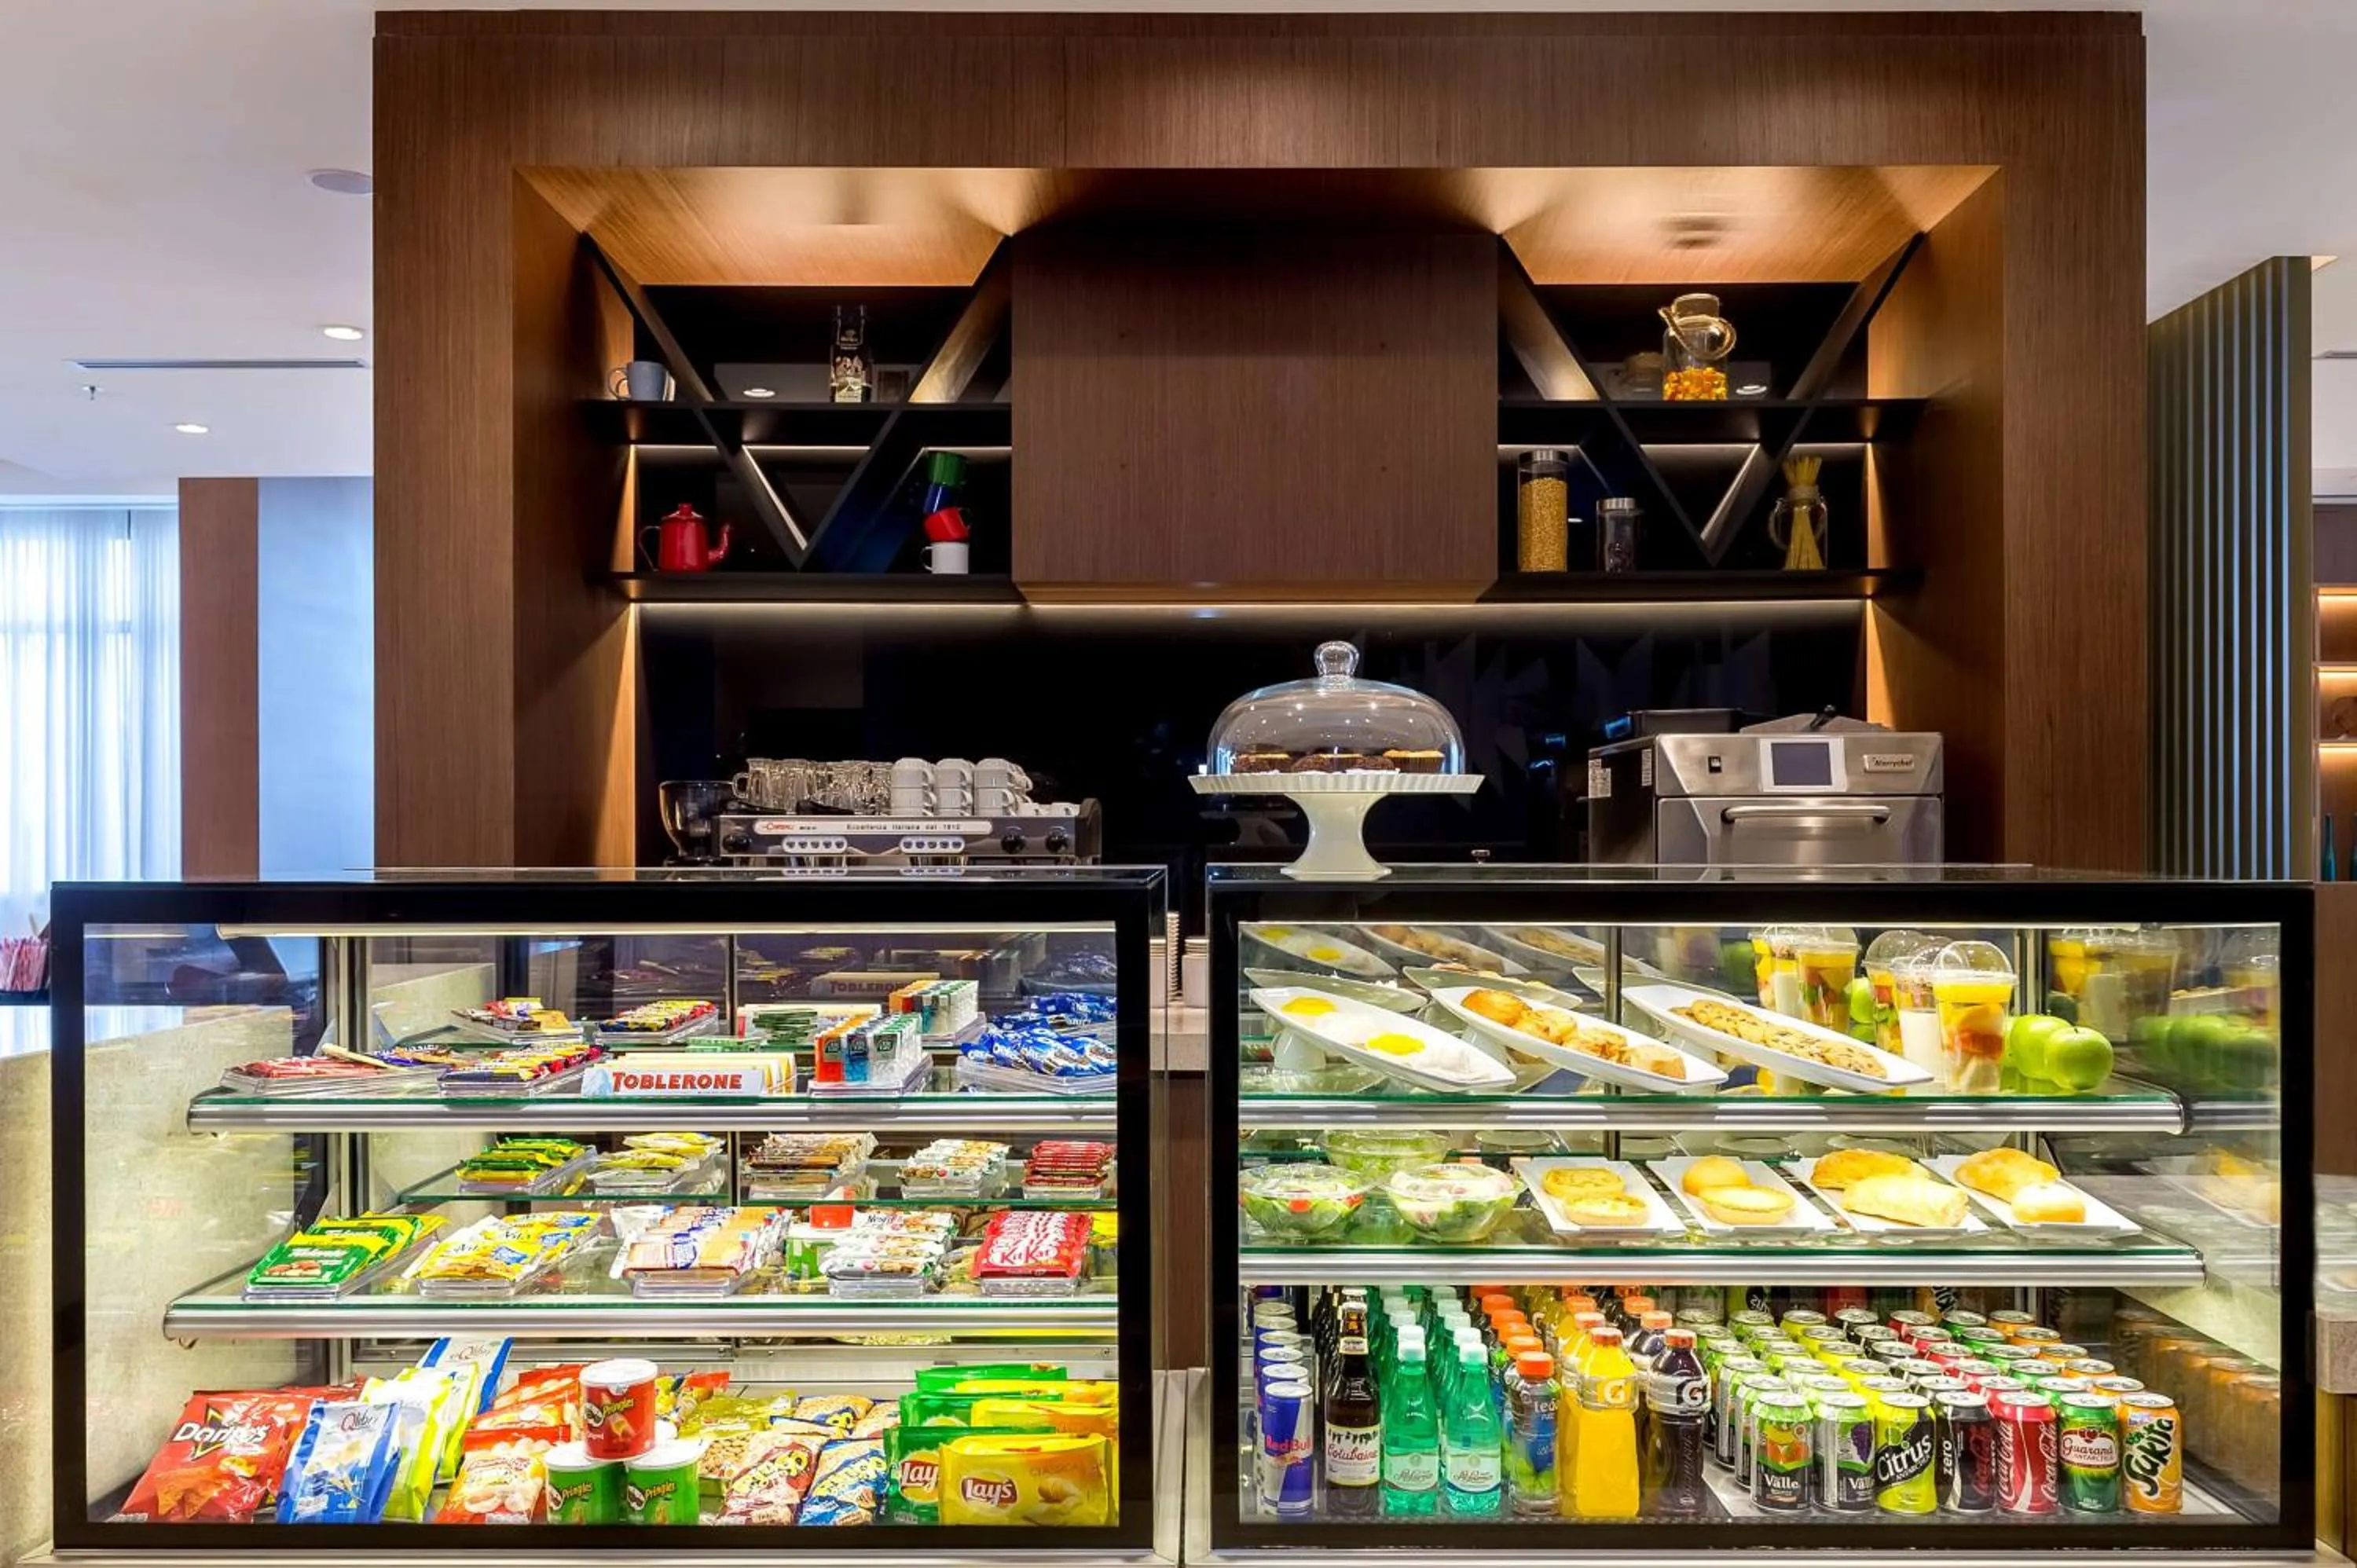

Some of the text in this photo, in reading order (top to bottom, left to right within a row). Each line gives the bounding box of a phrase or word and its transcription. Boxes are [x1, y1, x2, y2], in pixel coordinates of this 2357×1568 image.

[829, 981, 902, 995] TOBLERO
[612, 1072, 742, 1091] TOBLERONE
[1604, 1380, 1626, 1404] G
[1682, 1380, 1706, 1406] G
[1878, 1434, 1932, 1482] Citrus
[1943, 1439, 1953, 1476] zero
[901, 1462, 939, 1493] Lay
[966, 1478, 1014, 1506] Lay's
